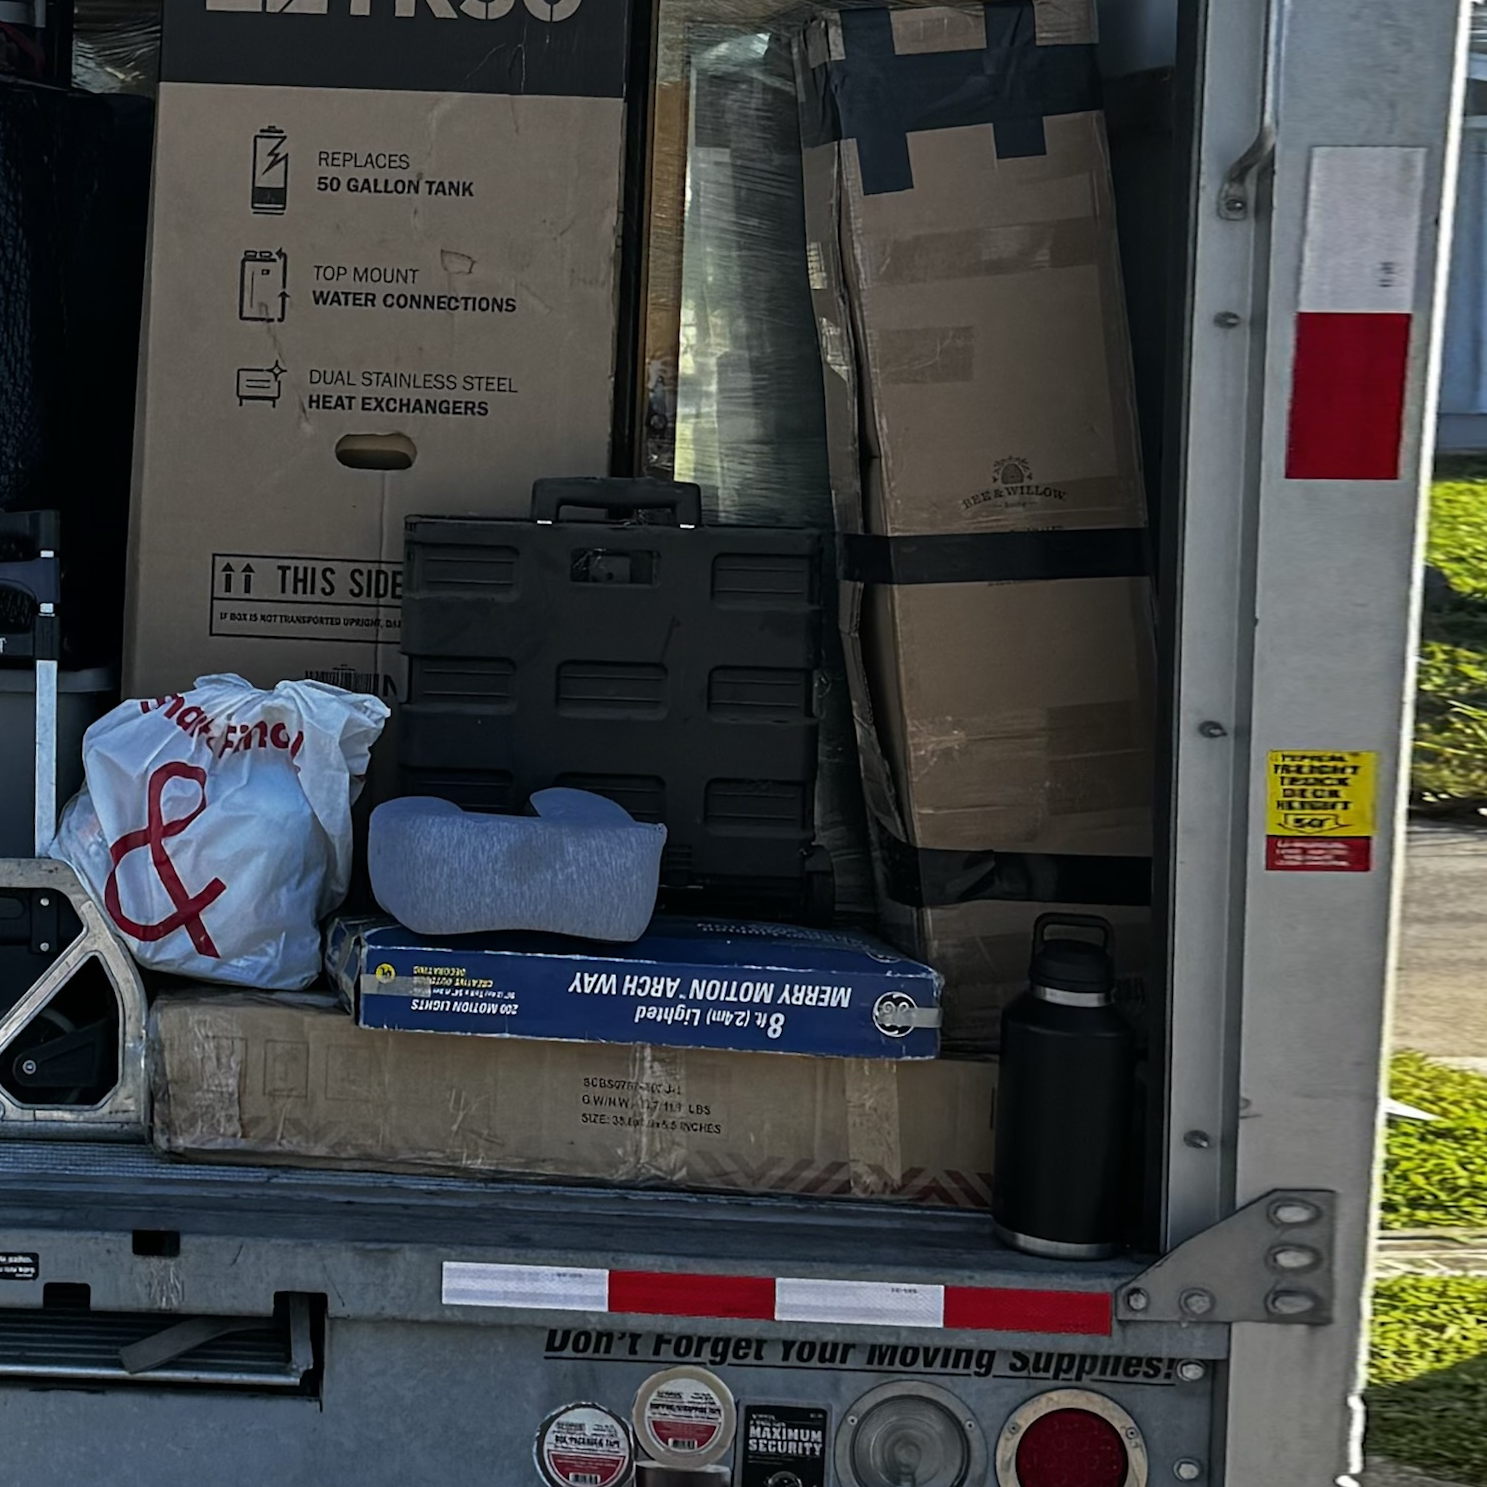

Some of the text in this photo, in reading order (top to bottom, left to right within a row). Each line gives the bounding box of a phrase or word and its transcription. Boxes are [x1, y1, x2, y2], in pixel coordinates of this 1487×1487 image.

[318, 150, 410, 170] REPLACES
[317, 176, 474, 197] 50 GALLON TANK
[314, 265, 420, 284] TOP MOUNT
[312, 290, 517, 313] WATER CONNECTIONS
[309, 369, 519, 394] DUAL STAINLESS STEEL
[308, 394, 489, 416] HEAT EXCHANGERS
[1005, 485, 1067, 501] WILLOW
[277, 565, 403, 600] THIS SIDE
[413, 975, 453, 987] OUTD
[567, 971, 617, 996] WAY
[622, 974, 681, 1000] ARCH
[776, 982, 853, 1009] MERRY
[410, 998, 520, 1016] 200 MOTION LIGHTS
[633, 1004, 702, 1027] Lighted
[545, 1329, 1180, 1381] Don't Forget Your Moving Supplies!
[749, 1425, 823, 1442] MAXIMUM
[748, 1438, 823, 1456] SECURITY
